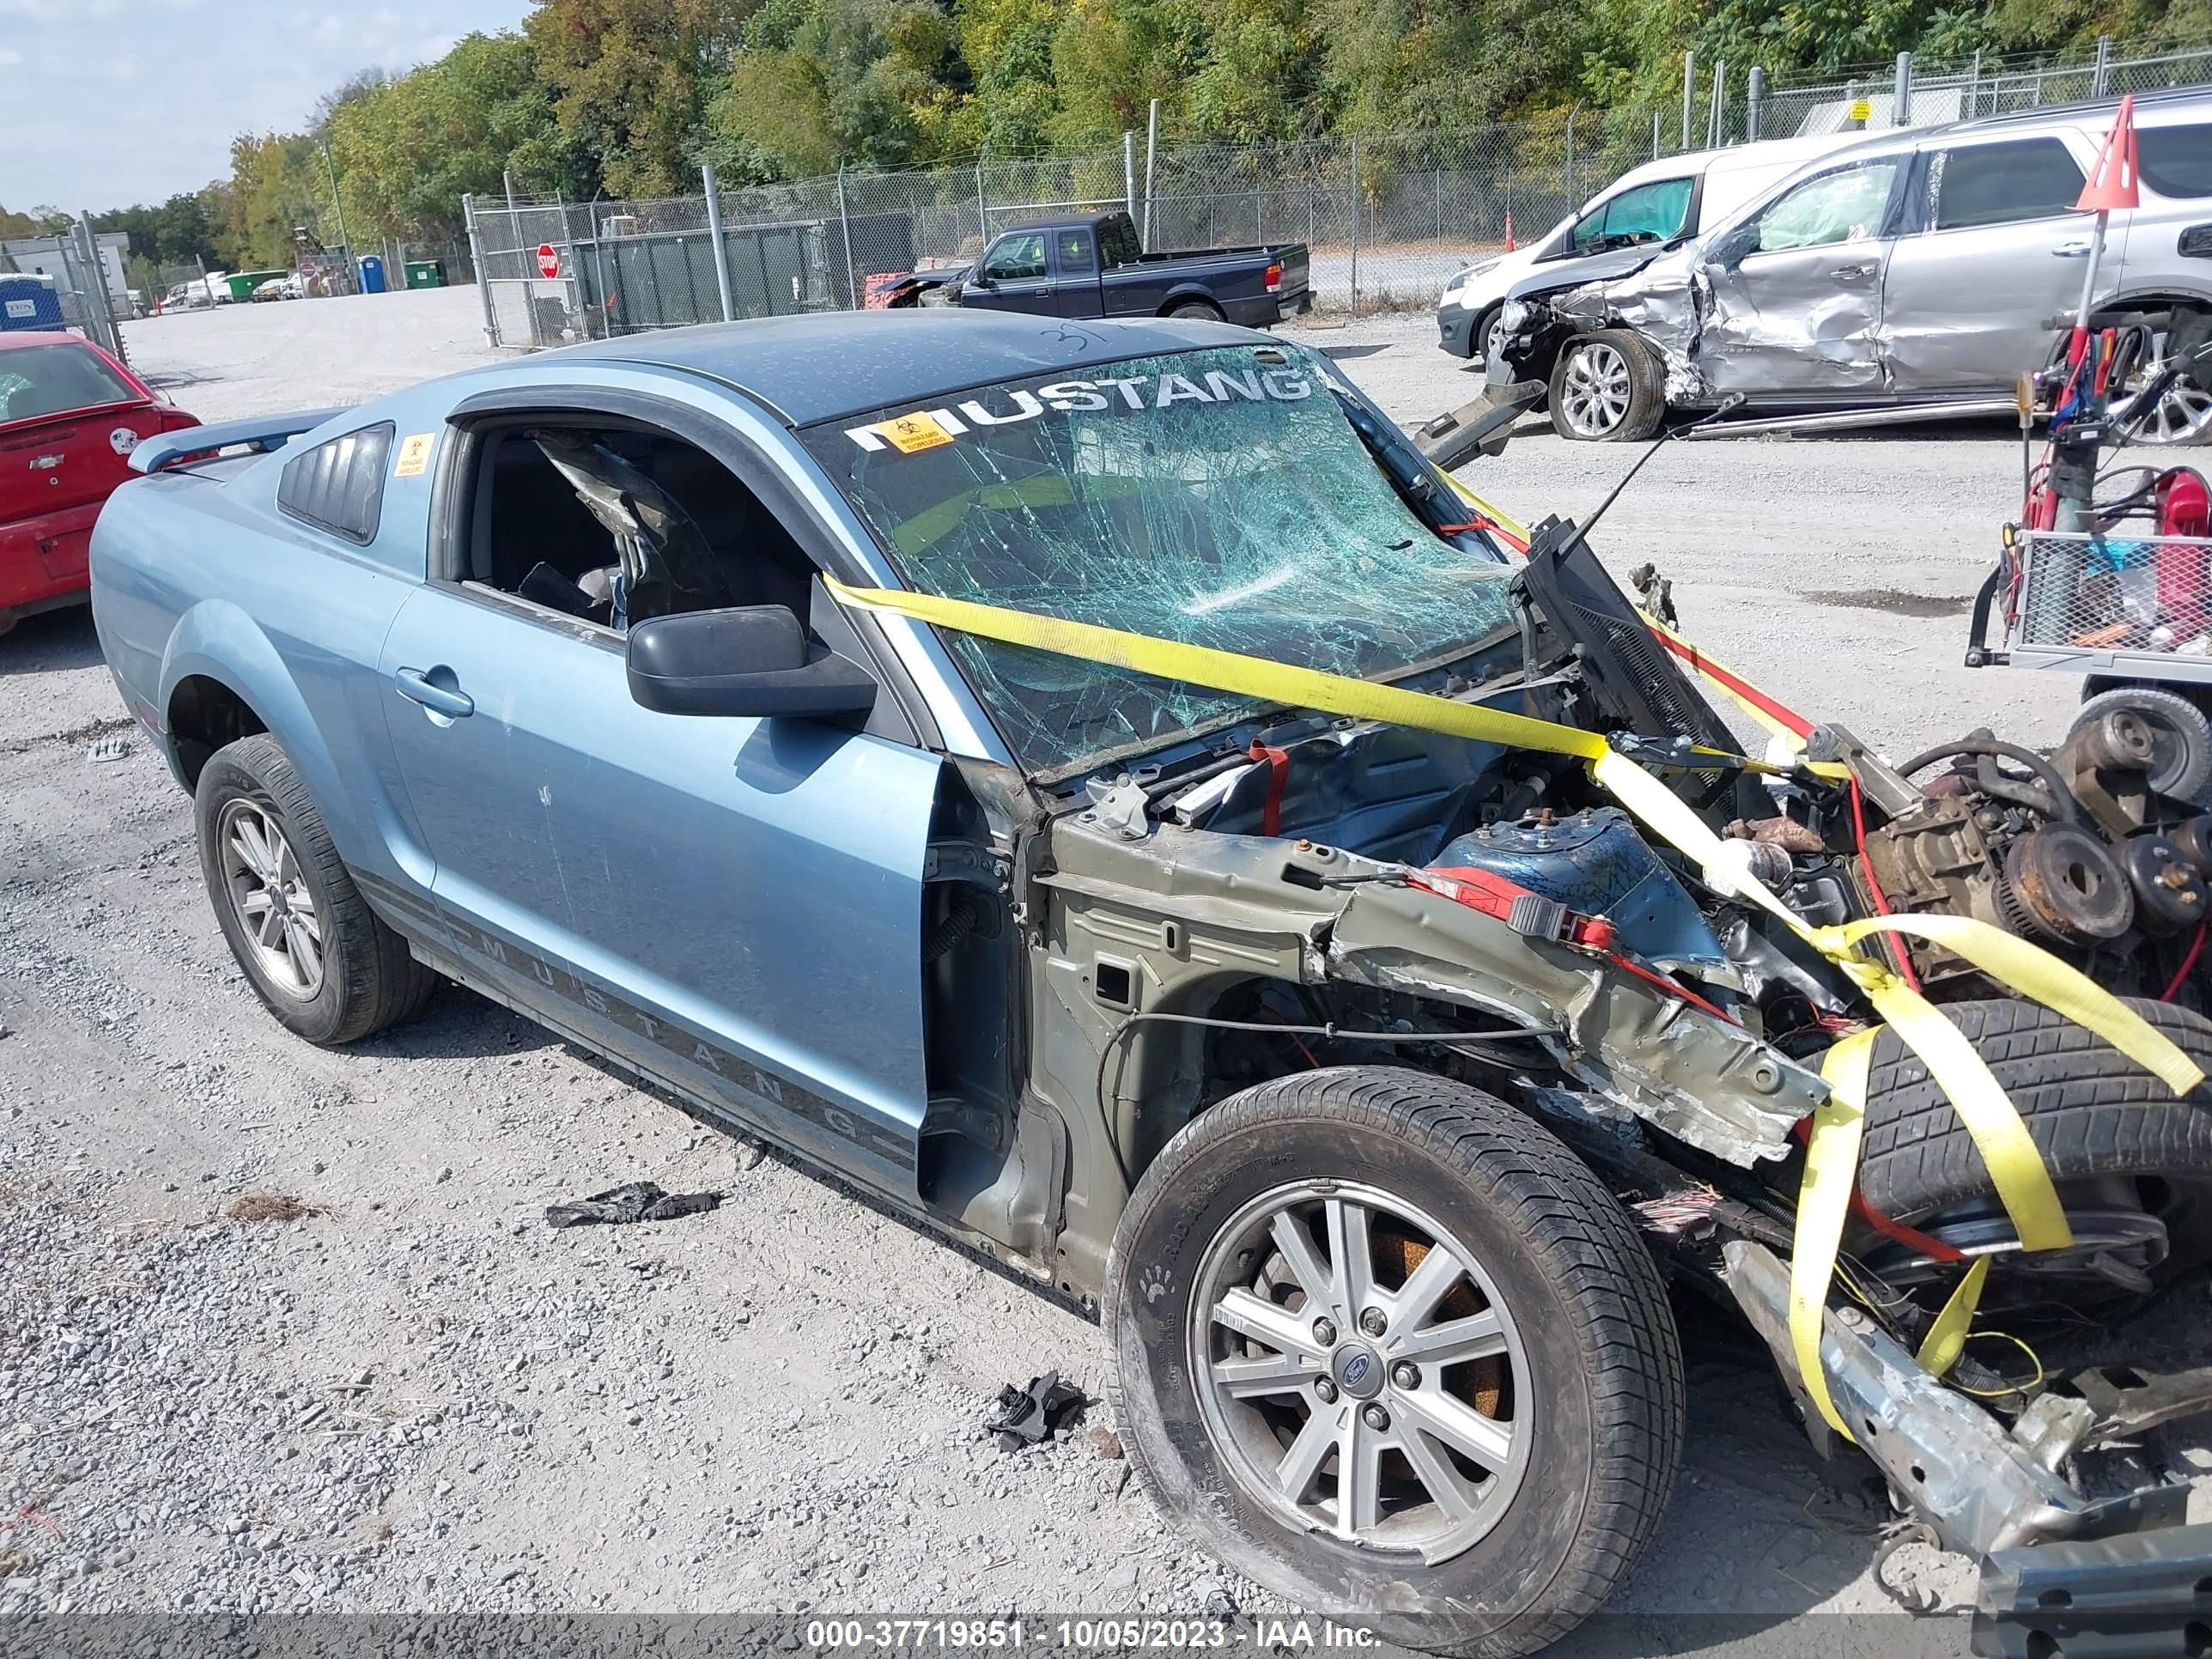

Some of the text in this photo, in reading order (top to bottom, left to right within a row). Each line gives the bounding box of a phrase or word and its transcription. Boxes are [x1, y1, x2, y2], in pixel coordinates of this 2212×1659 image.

[539, 255, 556, 270] STOP
[900, 432, 939, 445] BIOHAZARD
[1348, 1360, 1364, 1381] Ford
